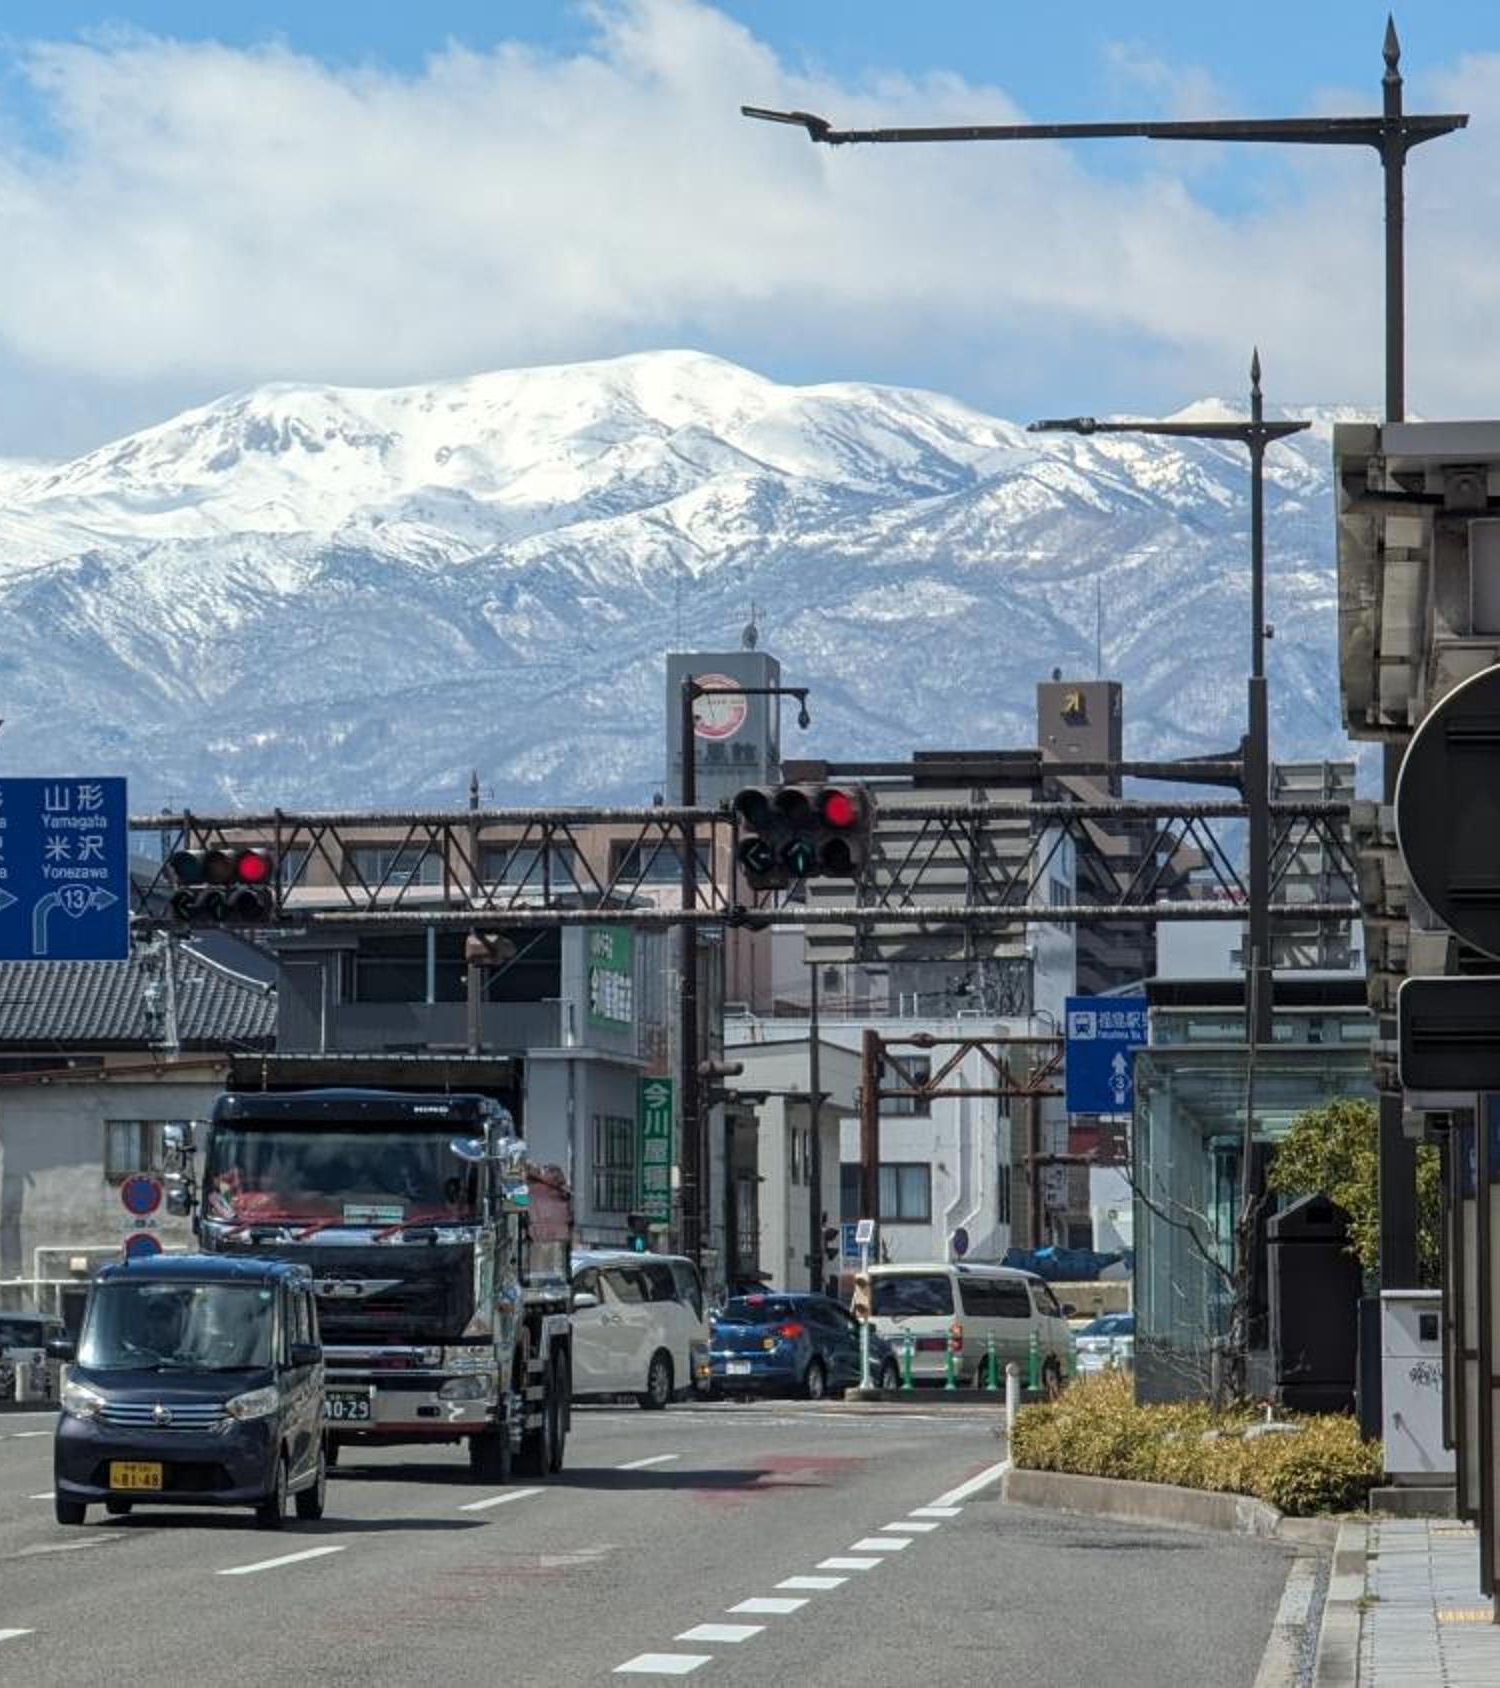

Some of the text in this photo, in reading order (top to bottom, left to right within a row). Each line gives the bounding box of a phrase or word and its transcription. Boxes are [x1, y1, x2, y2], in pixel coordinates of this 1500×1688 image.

[45, 785, 104, 812] 山形
[41, 815, 107, 831] Yamagata
[45, 836, 106, 861] 米沢
[42, 865, 108, 880] Yonezawa
[65, 889, 85, 910] 13
